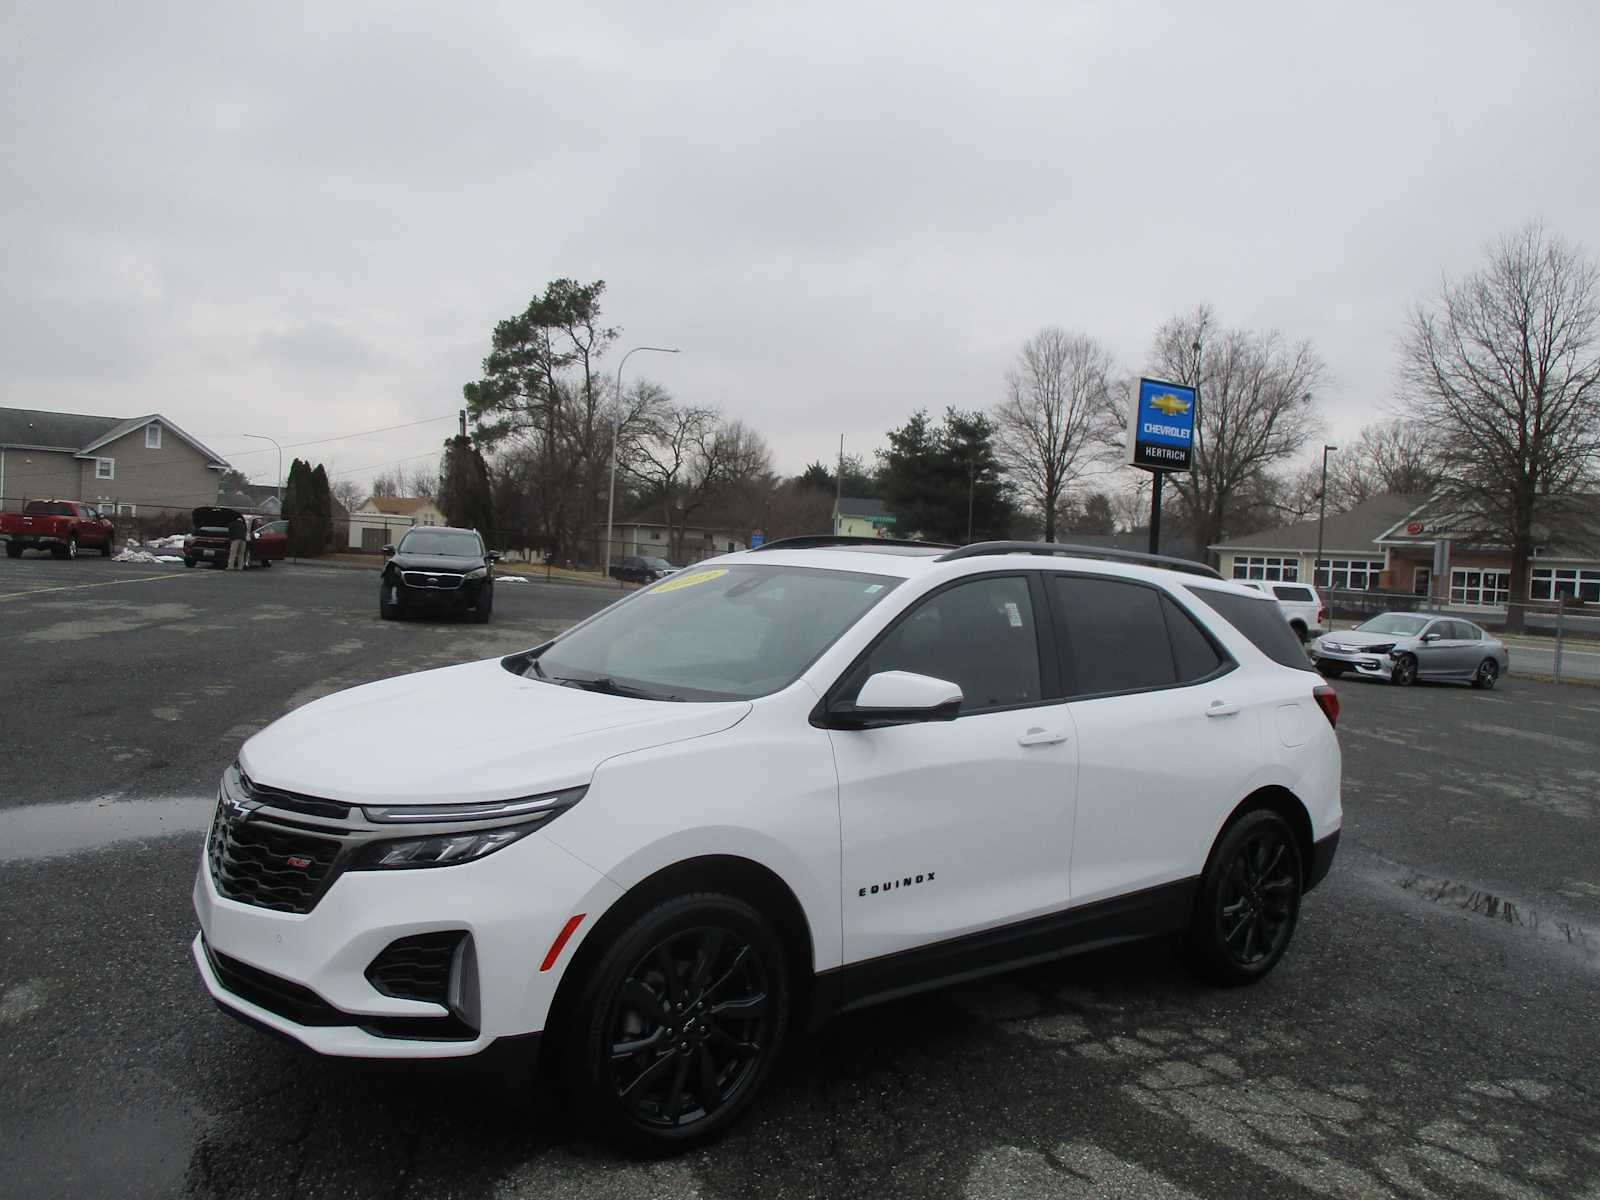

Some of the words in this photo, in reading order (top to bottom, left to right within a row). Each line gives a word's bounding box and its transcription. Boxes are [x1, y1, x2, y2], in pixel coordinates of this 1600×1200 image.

[1143, 423, 1191, 439] CHEVROLET
[1145, 446, 1185, 461] HERTRICH
[858, 871, 936, 897] EQUINOX
